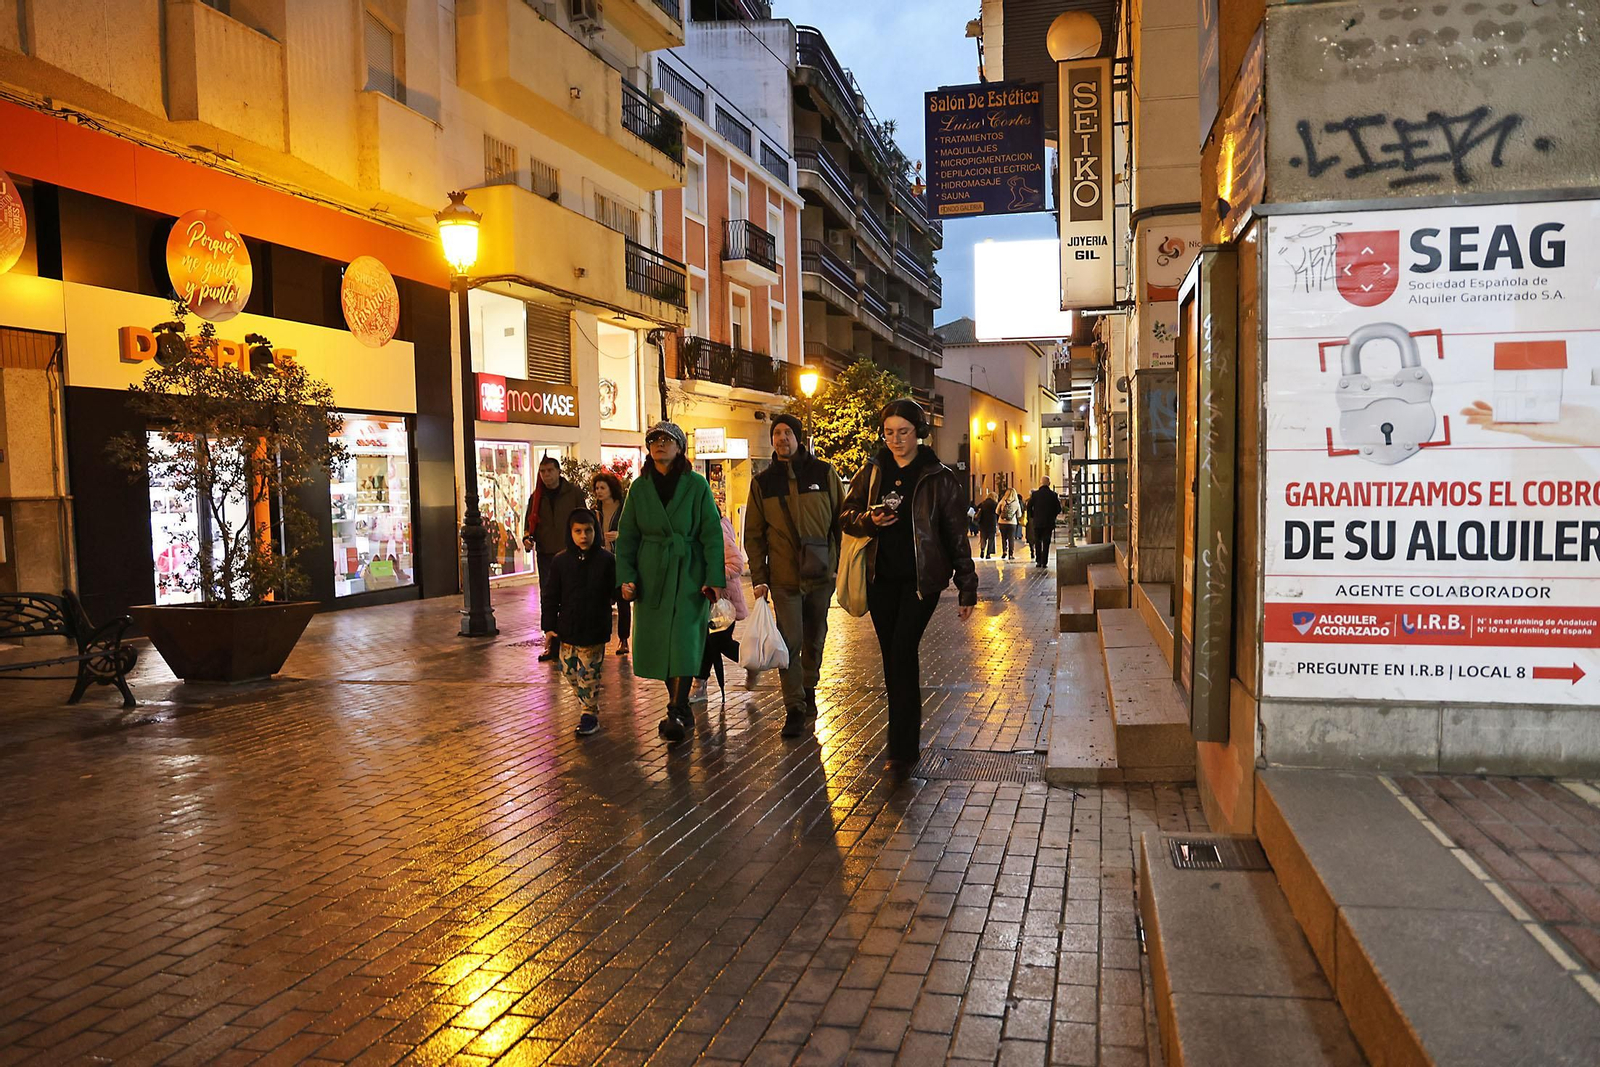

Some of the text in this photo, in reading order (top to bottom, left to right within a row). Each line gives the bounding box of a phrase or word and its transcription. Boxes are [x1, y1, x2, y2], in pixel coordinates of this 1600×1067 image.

[930, 89, 1040, 112] Salón De Estética
[938, 110, 1032, 132] Luisa Cortes
[940, 132, 1004, 144] TRATAMIENTOS
[1072, 82, 1100, 207] SEIKO
[940, 144, 998, 156] MAQUILLAJES
[940, 153, 1033, 168] MICROPIGMENTACION
[941, 164, 1041, 179] DEPILACION ELECTRICA
[941, 177, 1002, 190] HIDROMASAJE
[941, 191, 970, 201] SAUNA
[186, 220, 236, 260] Porque
[1067, 235, 1108, 248] JOYERIA
[1408, 222, 1566, 273] SEAG
[1075, 250, 1100, 260] GIL
[182, 254, 239, 284] me gusta
[1408, 276, 1548, 291] Sociedad Española de
[184, 281, 198, 305] y
[1408, 290, 1565, 306] Alquiler Garantizado S.A.
[354, 284, 391, 326] fashion
[1285, 481, 1482, 507] GARANTIZAMOS
[1490, 481, 1516, 506] EL
[1284, 520, 1600, 562] DE SU ALQUILER
[1336, 584, 1551, 599] AGENTE COLABORADOR
[1319, 615, 1377, 626] ALQUILER
[1417, 614, 1466, 630] I.R.B.
[1313, 625, 1389, 636] ACORAZADO
[1563, 628, 1592, 637] España
[1297, 662, 1526, 679] PREGUNTE EN I.R.B LOCAL 8
